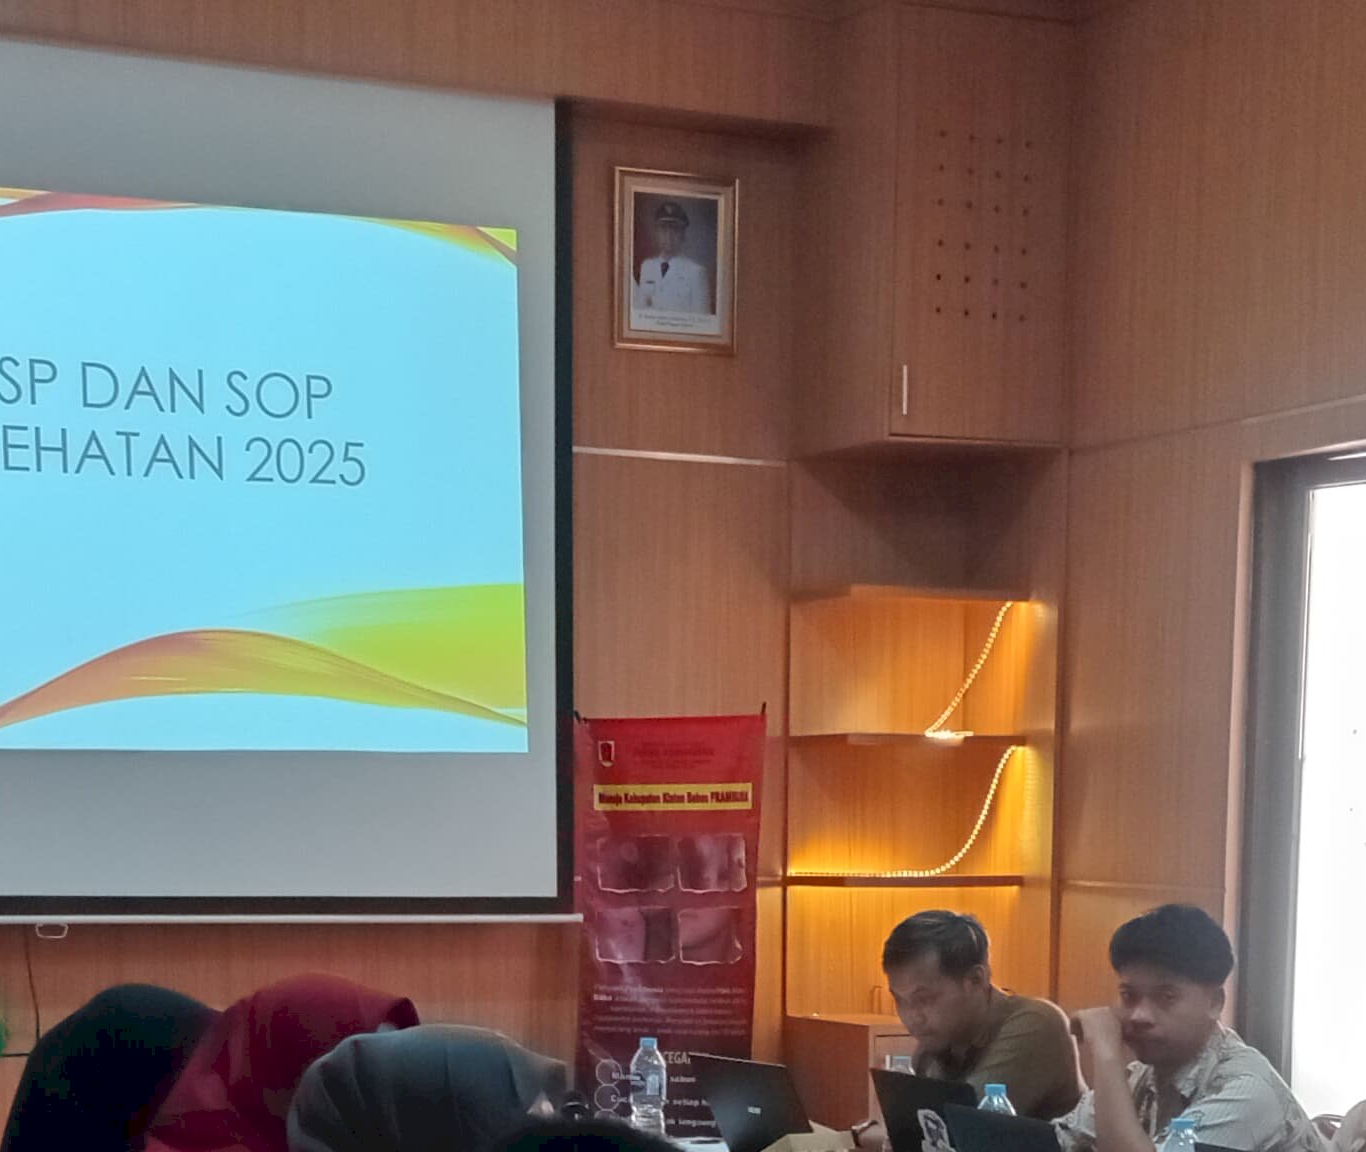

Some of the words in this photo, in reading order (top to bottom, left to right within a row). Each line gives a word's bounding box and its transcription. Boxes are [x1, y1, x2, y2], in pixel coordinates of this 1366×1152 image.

[80, 361, 206, 415] DAN
[224, 370, 334, 420] SOP
[244, 436, 366, 487] 2025
